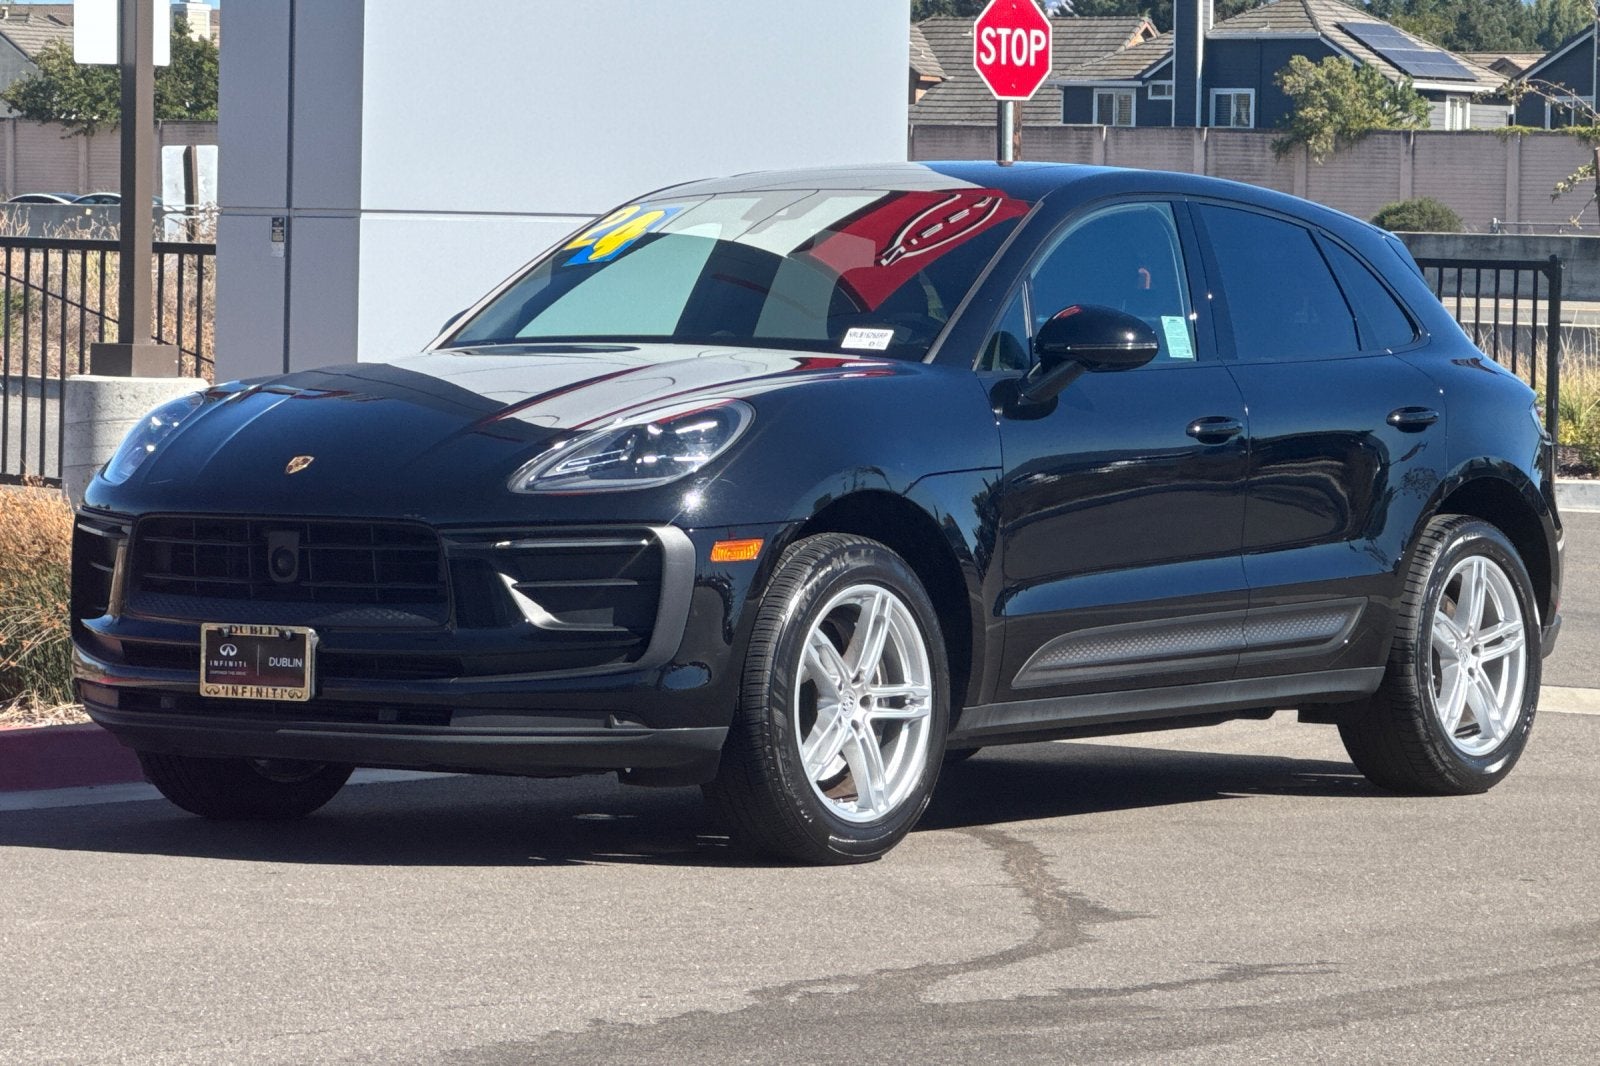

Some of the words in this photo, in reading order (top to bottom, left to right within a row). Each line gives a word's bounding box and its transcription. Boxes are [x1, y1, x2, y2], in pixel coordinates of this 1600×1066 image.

[980, 26, 1046, 67] STOP
[563, 205, 666, 261] 24
[210, 660, 247, 668] INFINITI
[268, 657, 303, 667] DUBLIN
[226, 686, 283, 699] INFINITI
